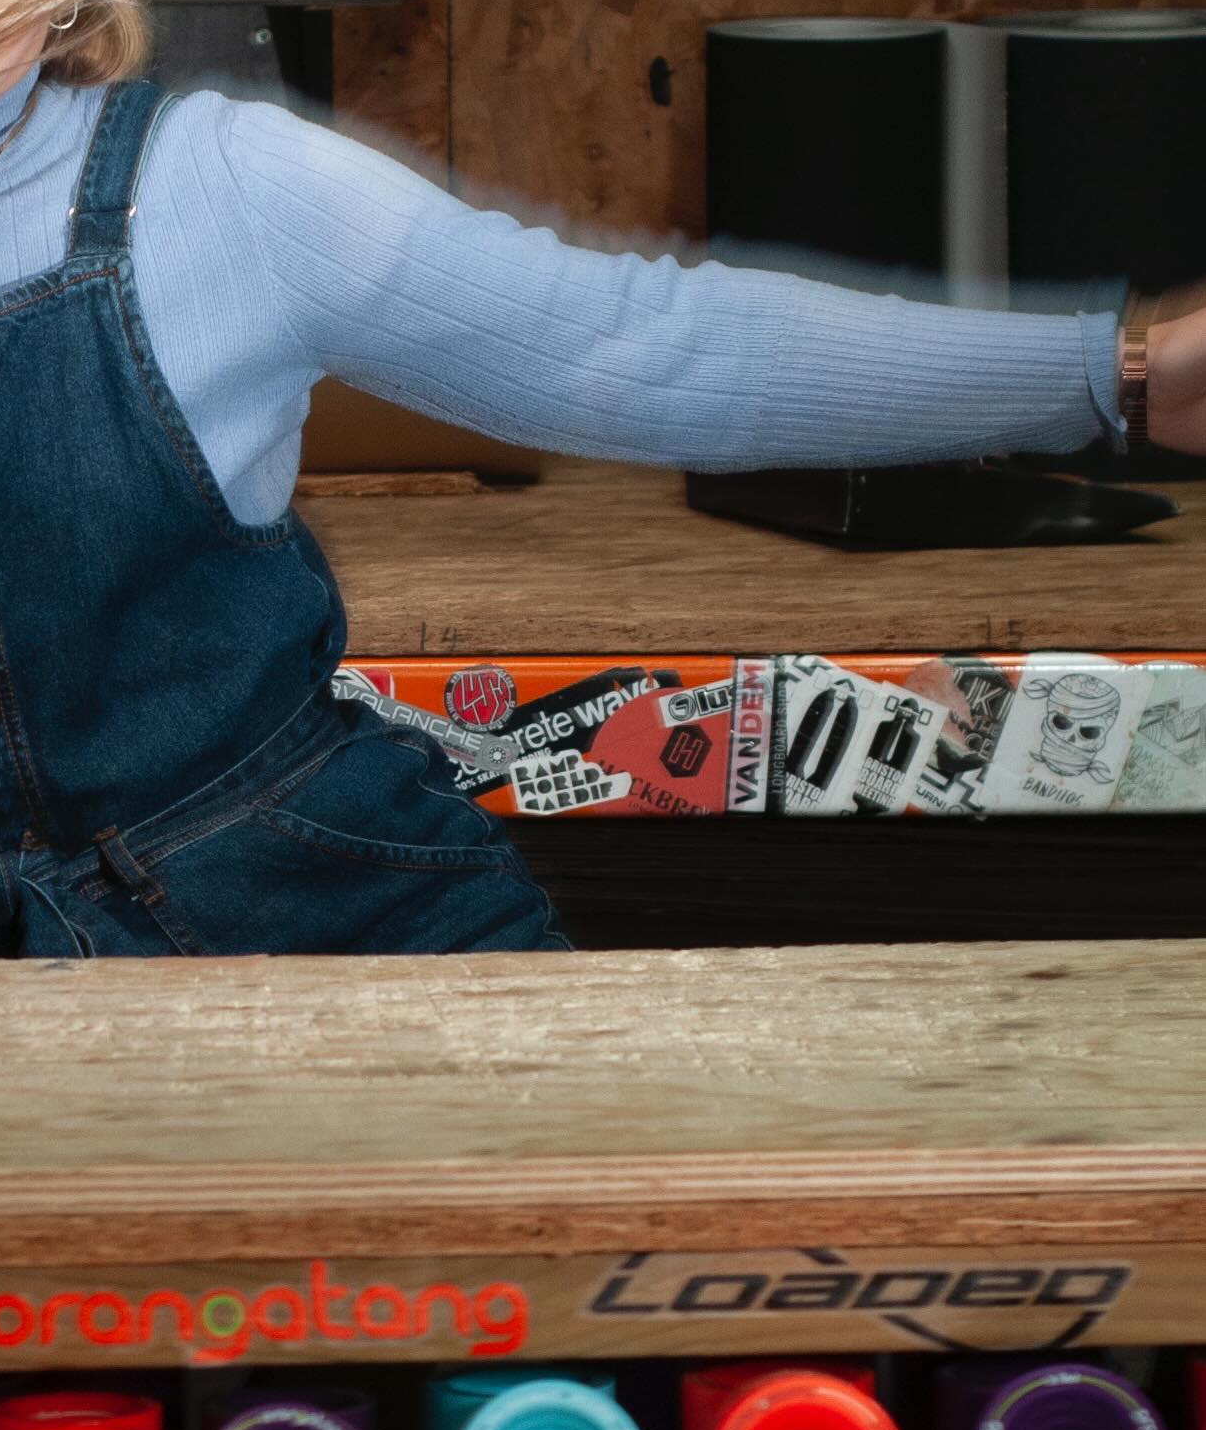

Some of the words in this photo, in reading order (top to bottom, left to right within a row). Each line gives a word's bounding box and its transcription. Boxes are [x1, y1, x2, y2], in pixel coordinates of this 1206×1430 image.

[695, 685, 734, 715] lu
[733, 661, 765, 805] VANDEM
[514, 753, 580, 783] RAMP
[770, 716, 788, 794] LONGBOARD
[519, 767, 601, 799] WORLD
[856, 783, 897, 807] MEETING
[860, 769, 900, 796] BOARD
[1023, 777, 1085, 807] BANDITOS
